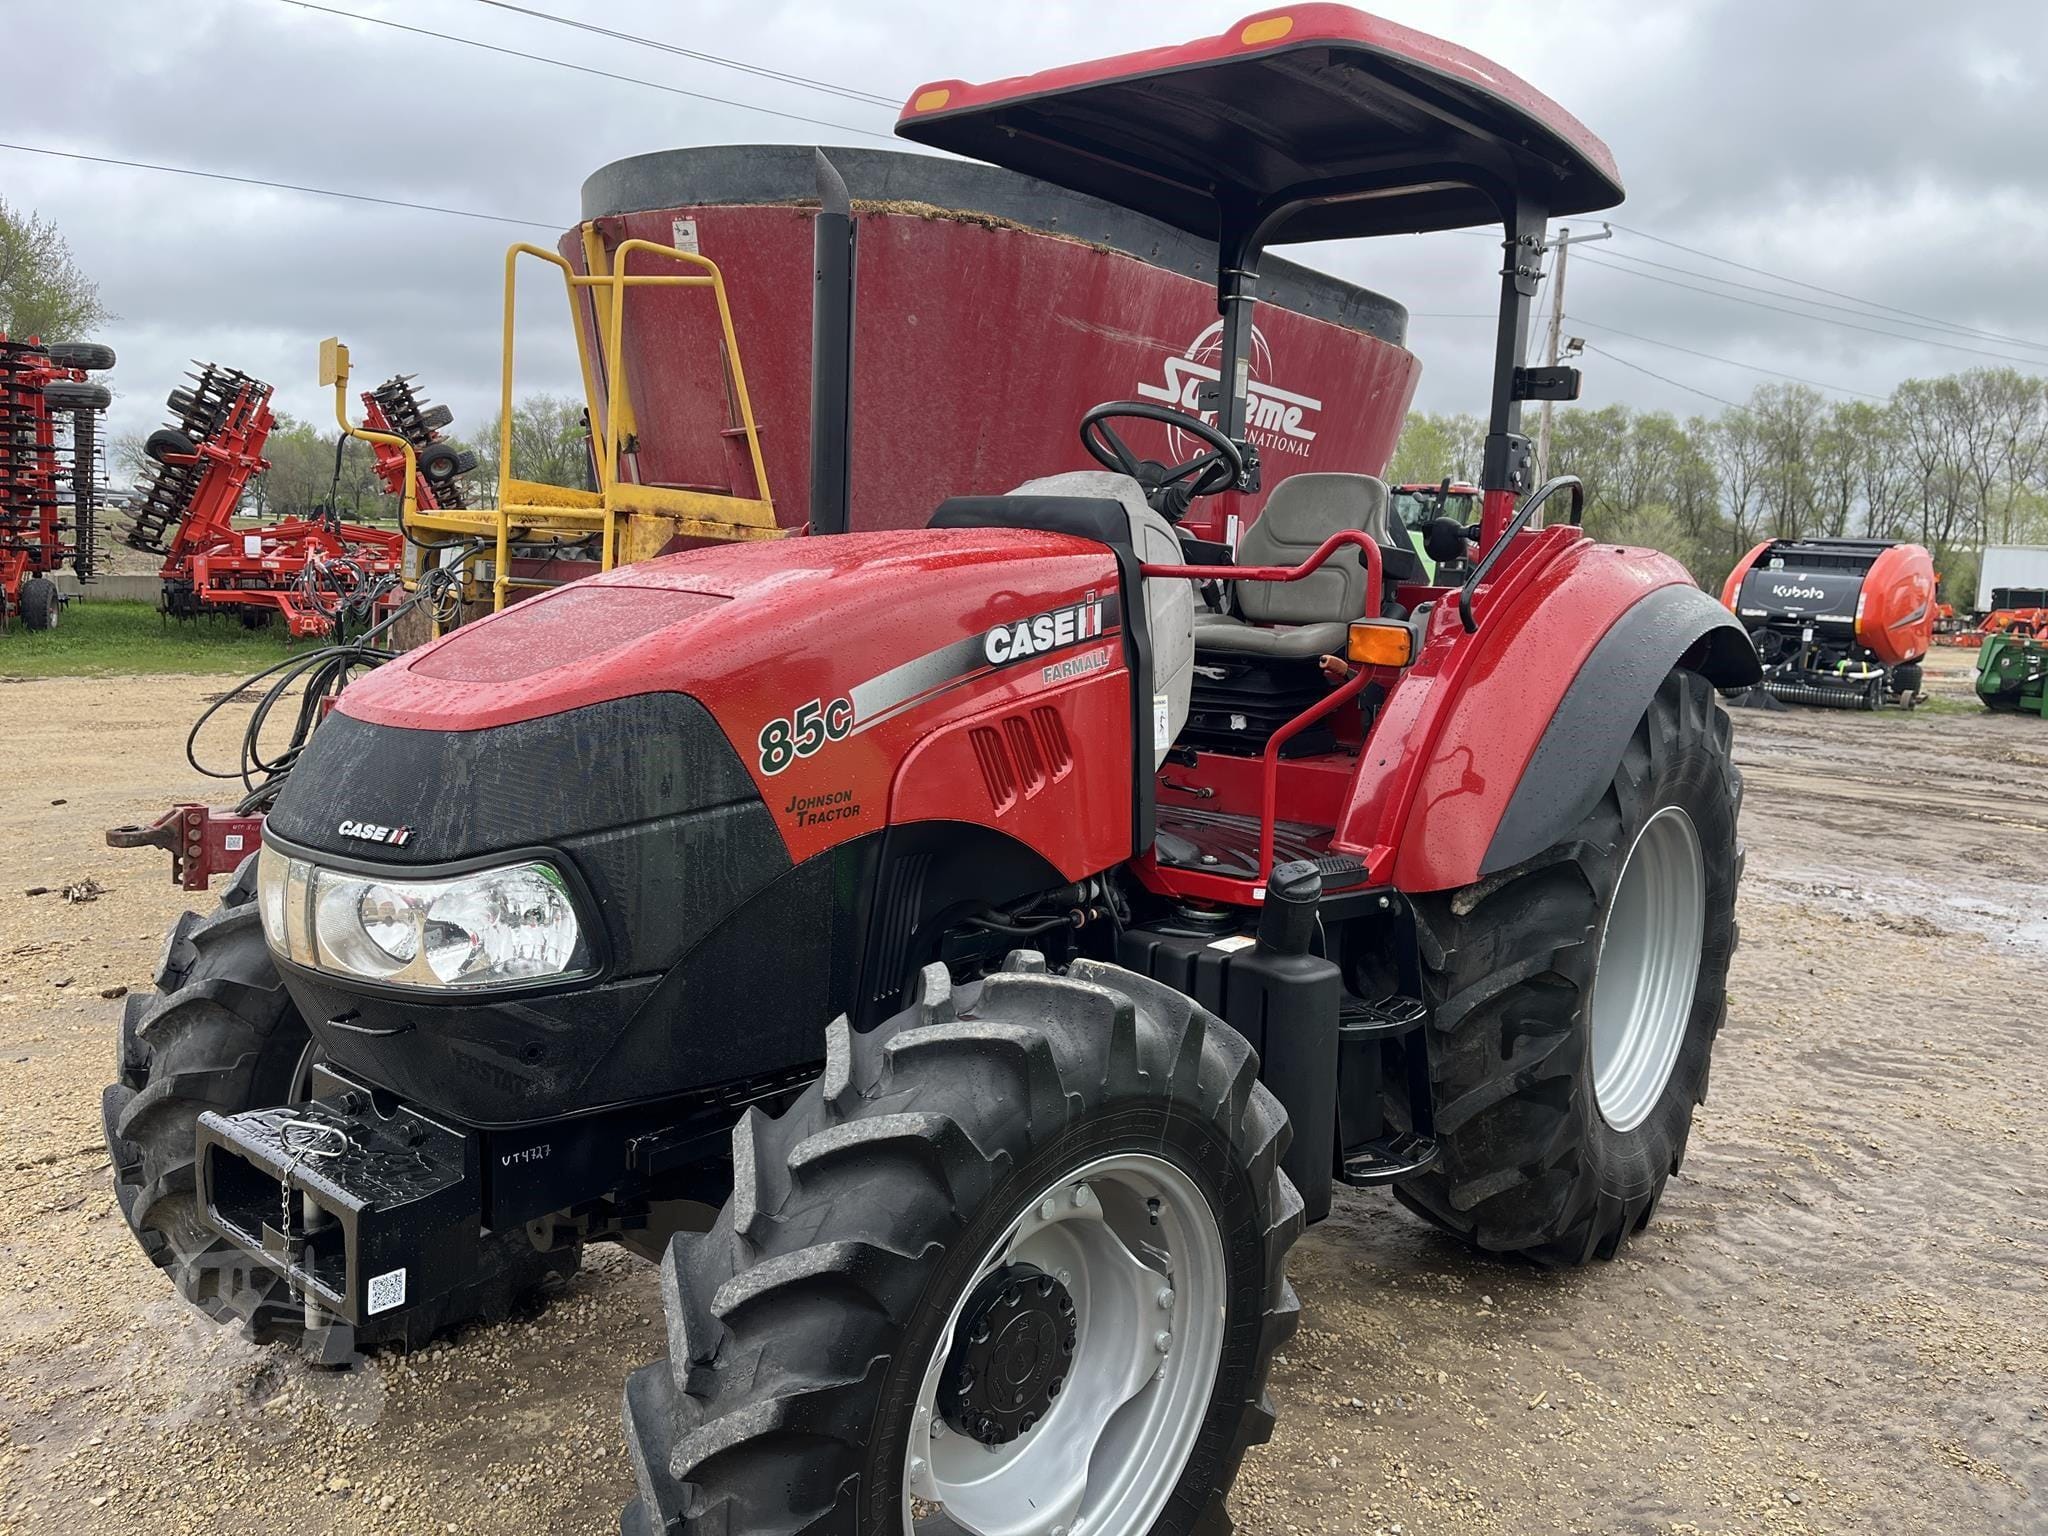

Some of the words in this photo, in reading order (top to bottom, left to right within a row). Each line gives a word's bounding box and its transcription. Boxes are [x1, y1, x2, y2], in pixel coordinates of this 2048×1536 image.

[1772, 585, 1825, 599] Kubota
[984, 608, 1076, 665] CASE
[1043, 652, 1110, 685] FARMALL
[785, 790, 853, 813] JOHNSON
[796, 805, 860, 827] TRACTOR
[338, 820, 389, 842] CASE
